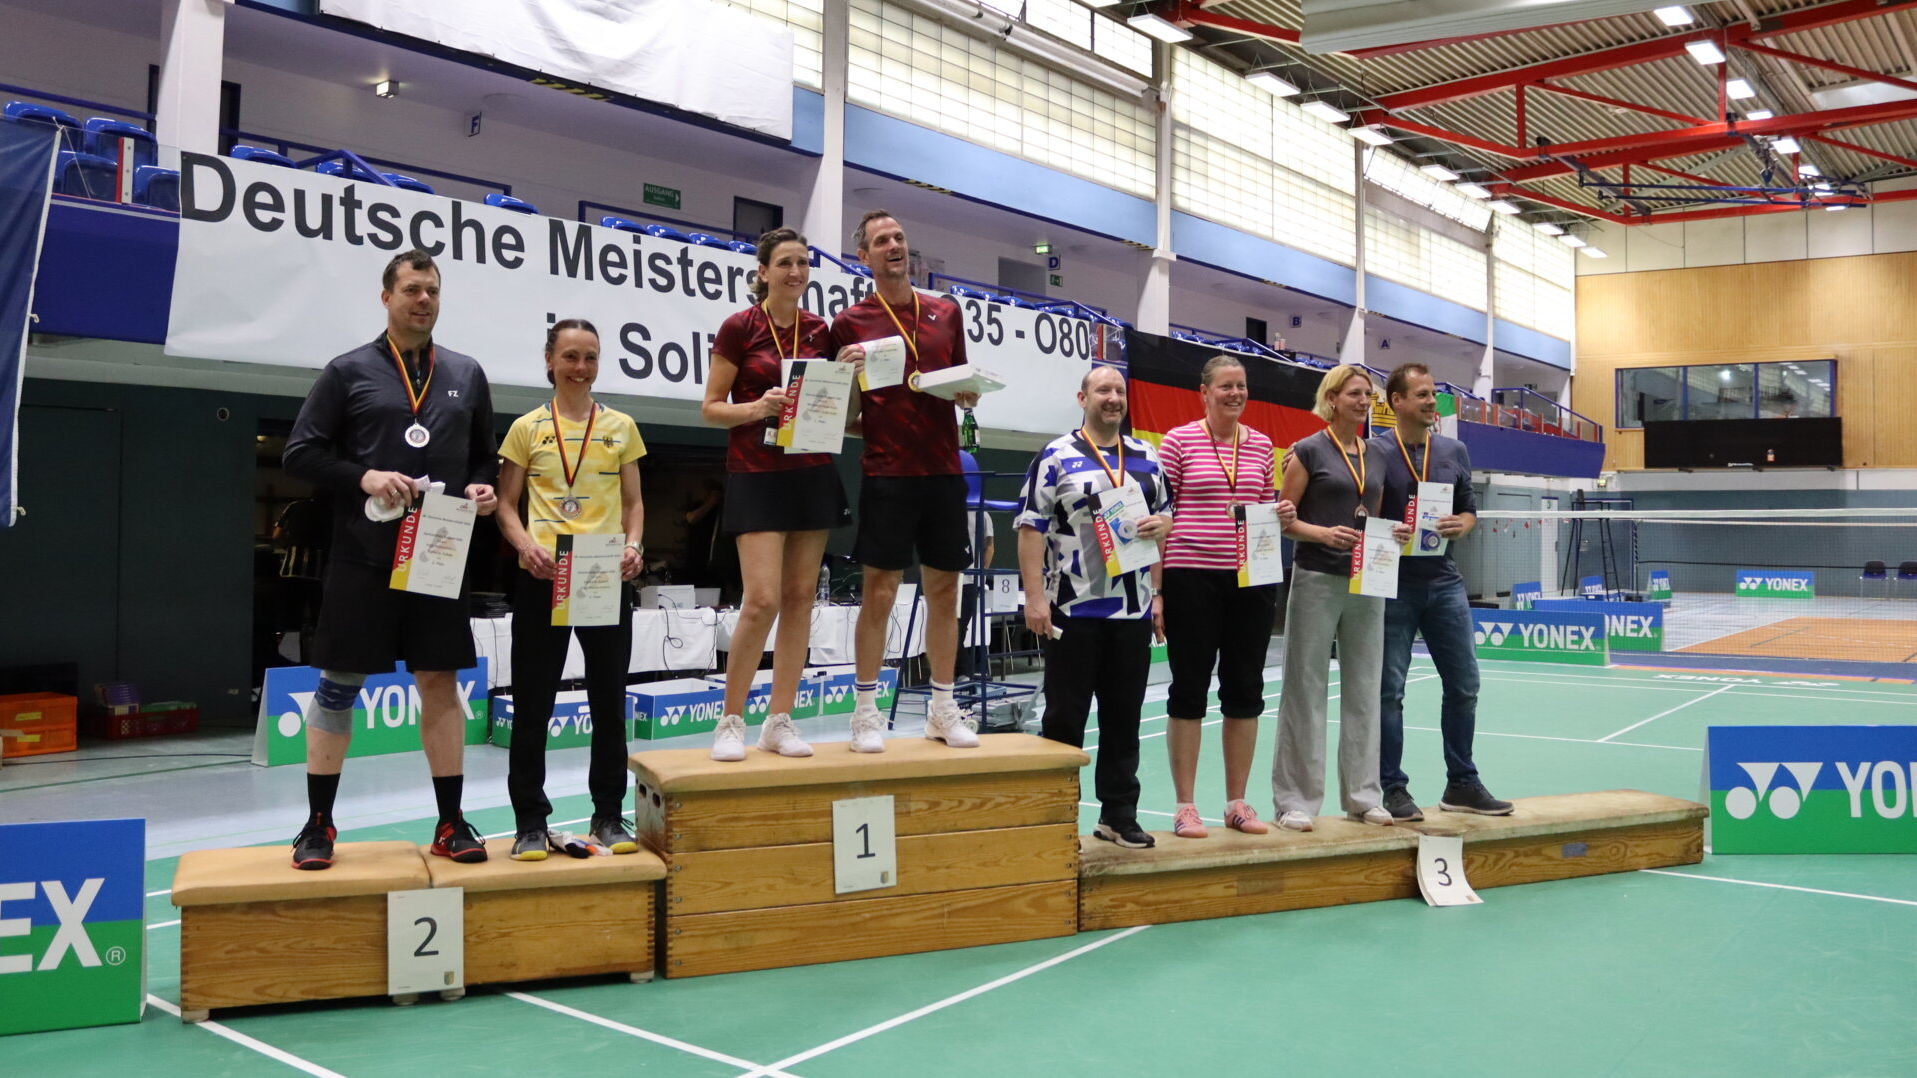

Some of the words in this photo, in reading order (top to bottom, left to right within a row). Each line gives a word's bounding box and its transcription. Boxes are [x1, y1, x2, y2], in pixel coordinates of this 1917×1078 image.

[181, 151, 525, 270] Deutsche
[1049, 256, 1059, 268] D
[1292, 316, 1301, 326] B
[1381, 339, 1389, 348] A
[783, 374, 801, 430] URKNDE
[397, 506, 418, 572] URKUNDE
[556, 550, 569, 610] URKUNDE
[1002, 579, 1010, 594] 8
[1765, 577, 1809, 592] YONEX
[1518, 623, 1596, 651] YONEX
[360, 680, 476, 729] YONX
[856, 823, 876, 859] 1
[1434, 857, 1452, 886] 3
[414, 916, 439, 957] 2
